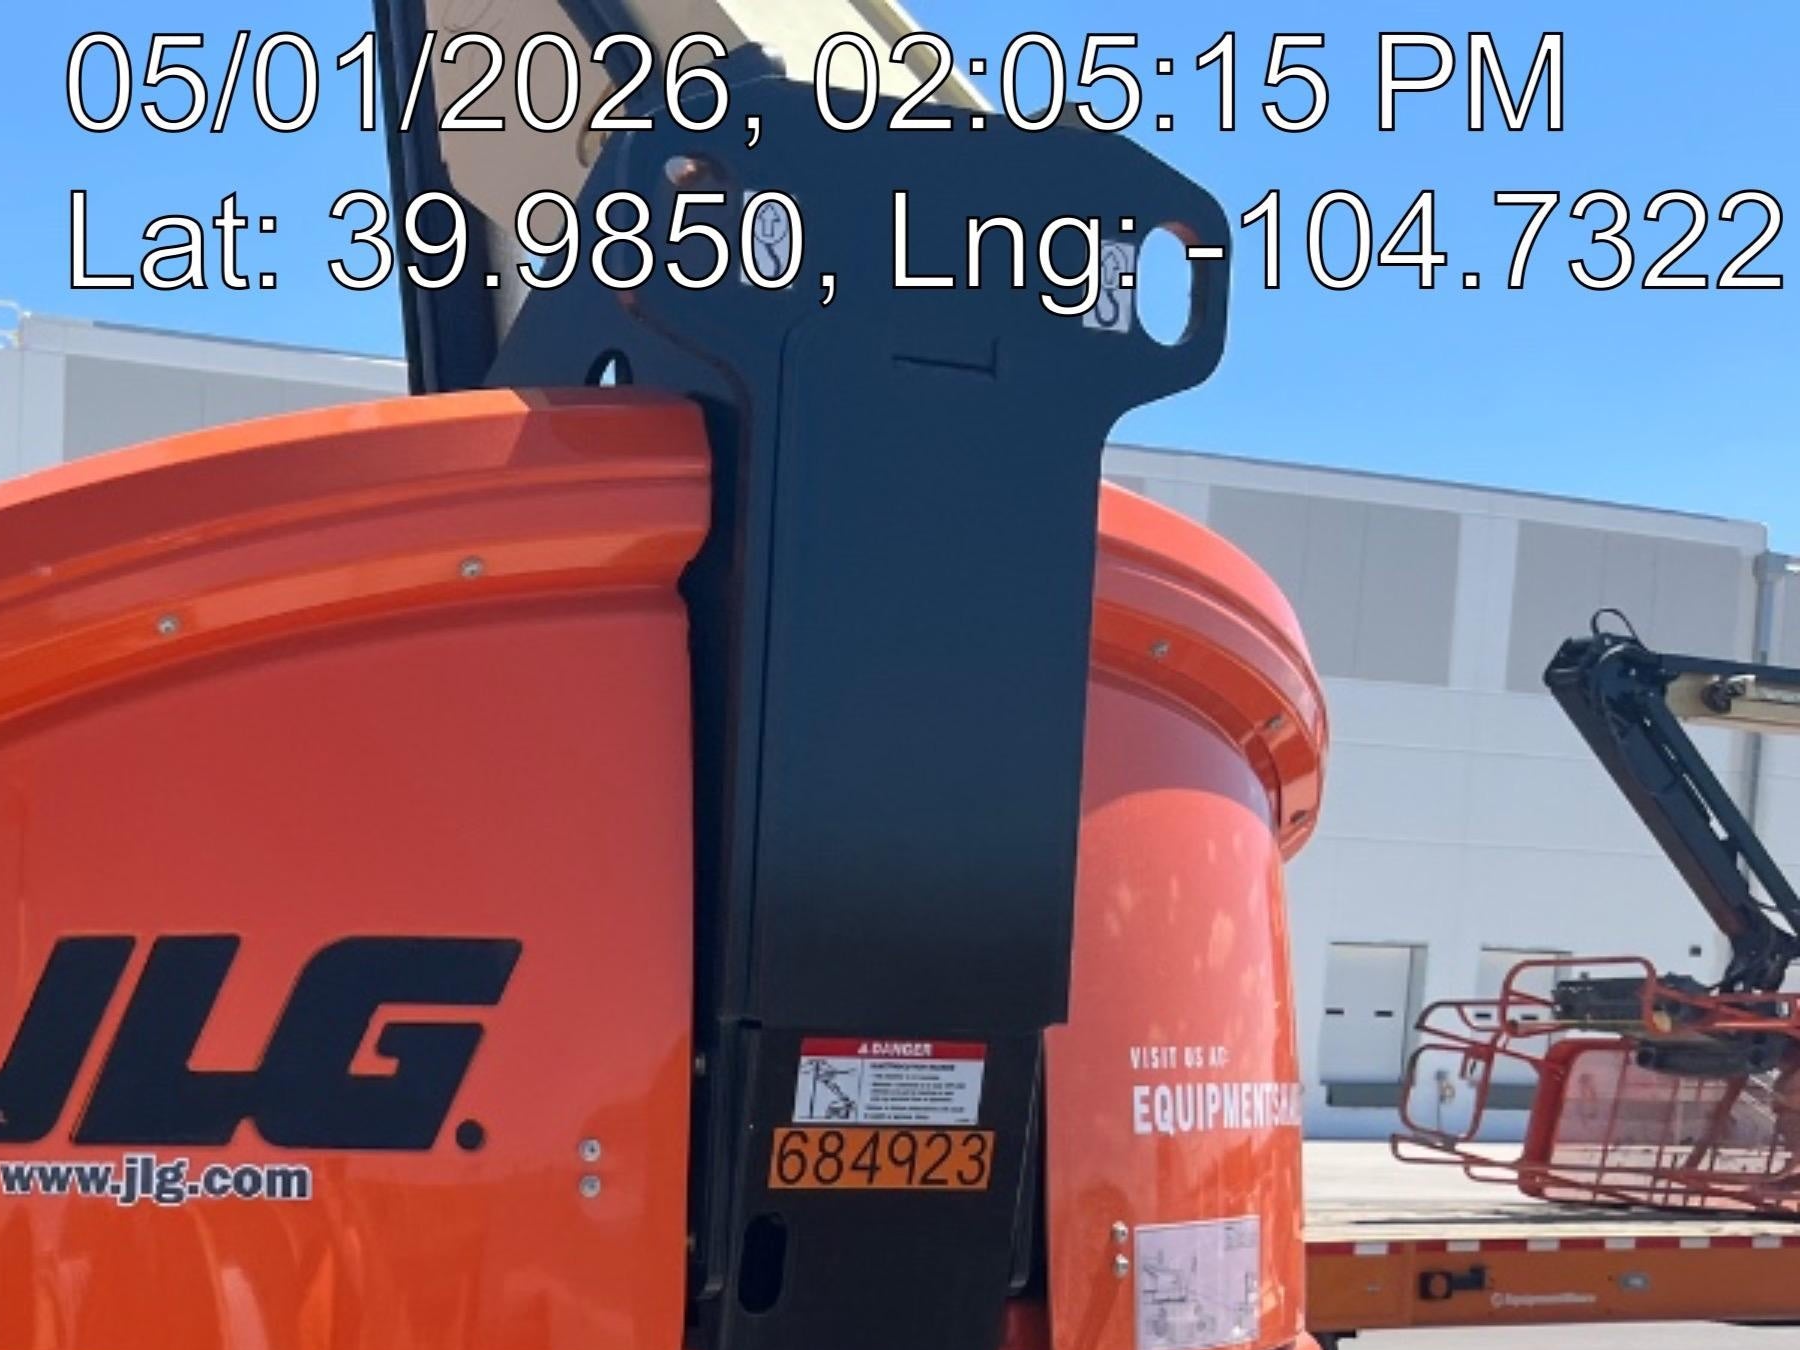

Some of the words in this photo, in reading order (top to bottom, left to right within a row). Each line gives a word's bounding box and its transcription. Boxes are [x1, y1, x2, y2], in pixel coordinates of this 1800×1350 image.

[871, 1043, 933, 1057] DANGER
[1130, 1046, 1177, 1069] VISIT
[1184, 1046, 1203, 1069] US
[776, 1129, 988, 1186] 684923
